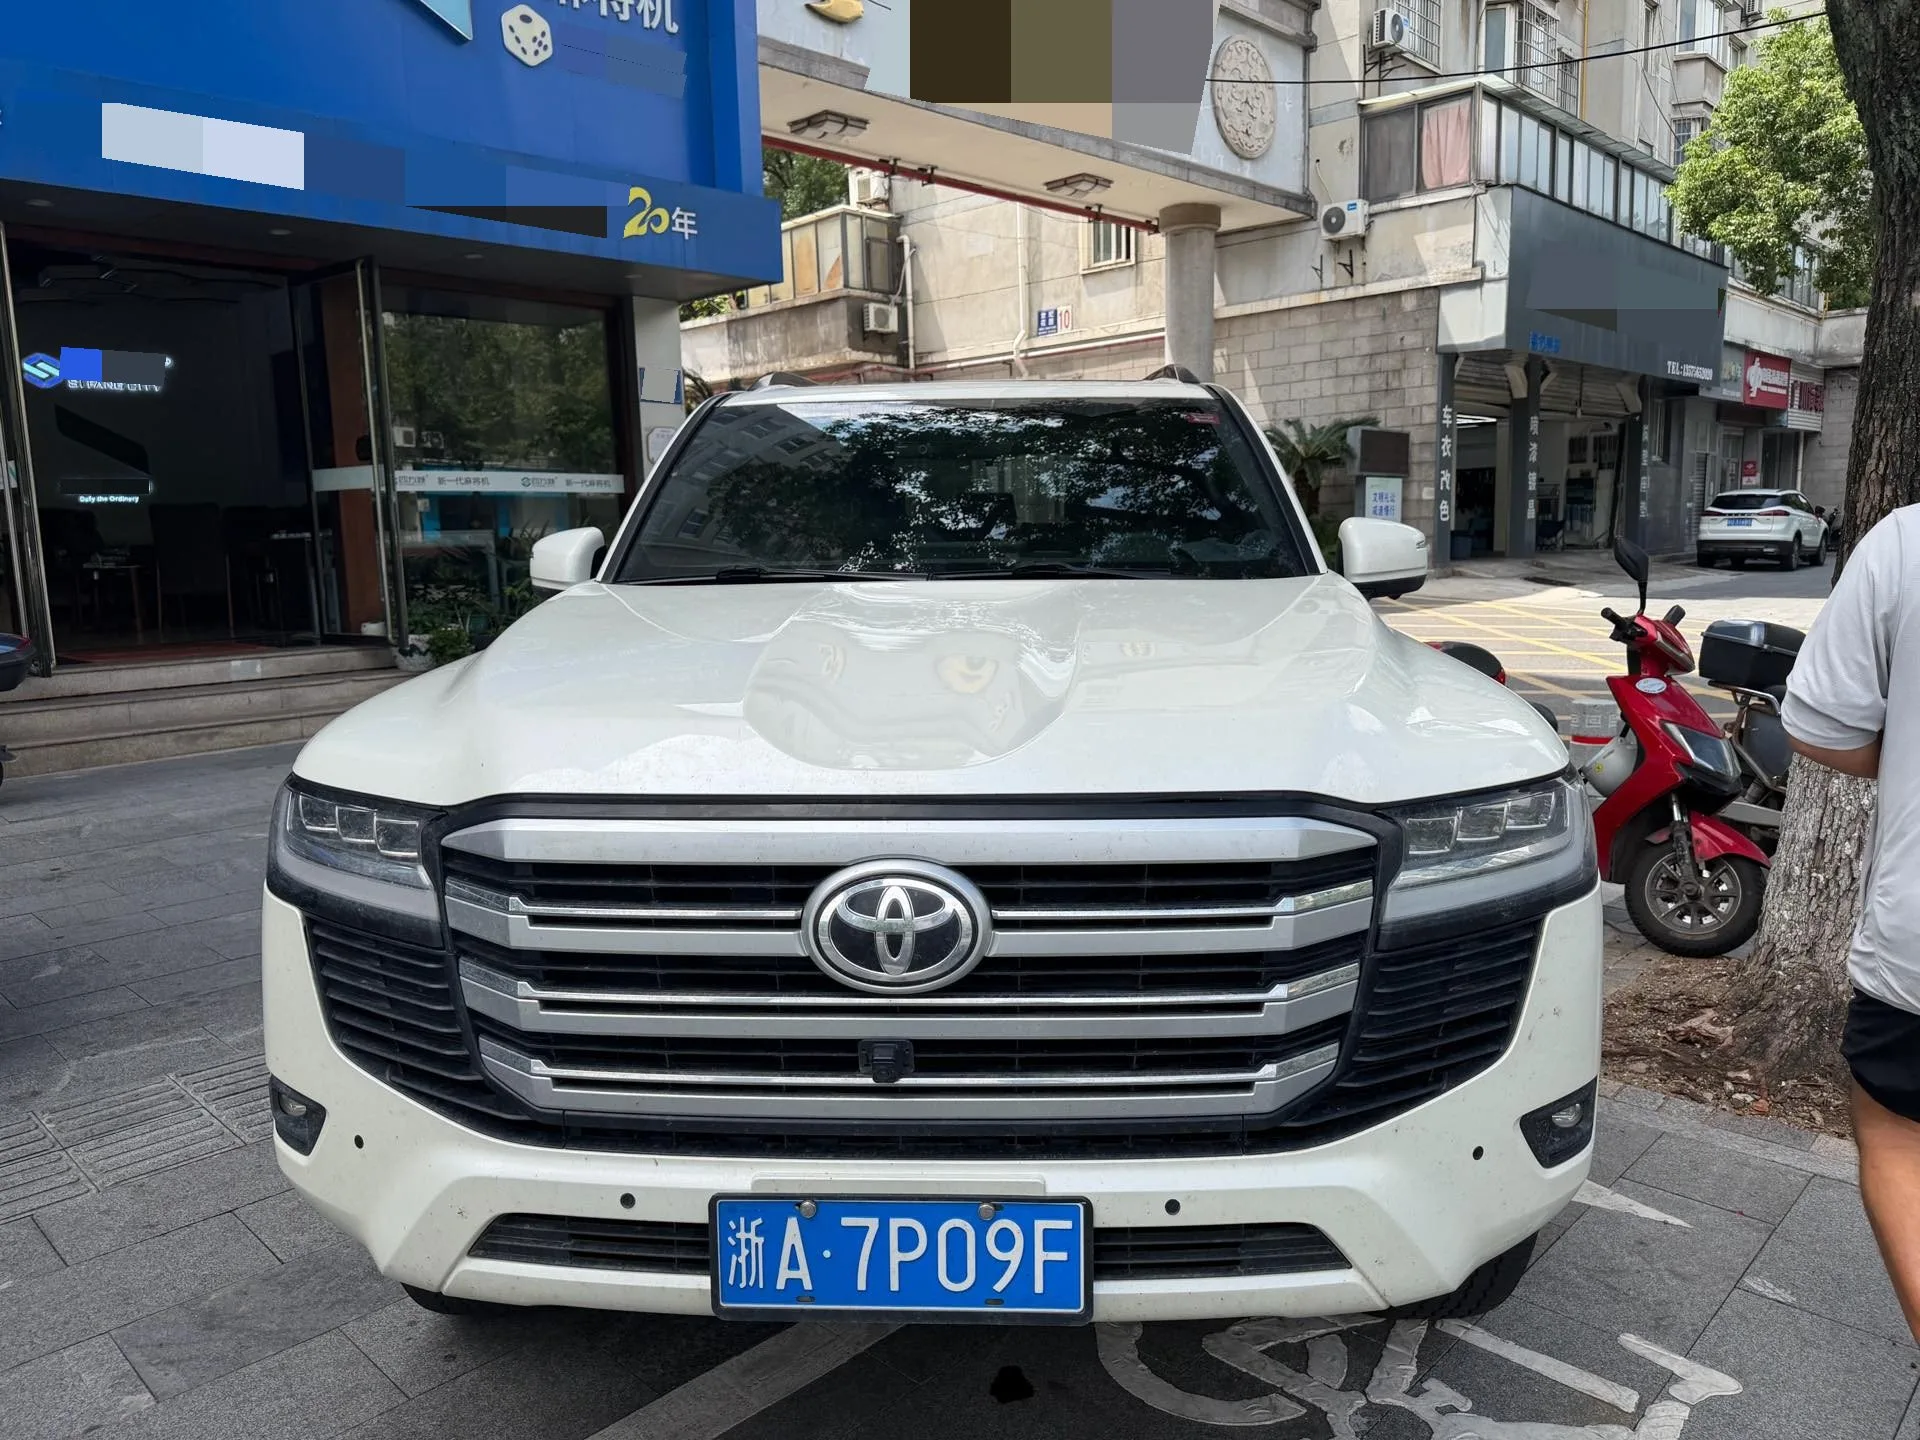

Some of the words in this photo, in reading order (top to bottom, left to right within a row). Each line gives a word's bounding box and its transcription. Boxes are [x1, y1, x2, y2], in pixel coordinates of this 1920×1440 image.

[1059, 309, 1071, 329] 10
[1439, 404, 1453, 522] 车衣改色
